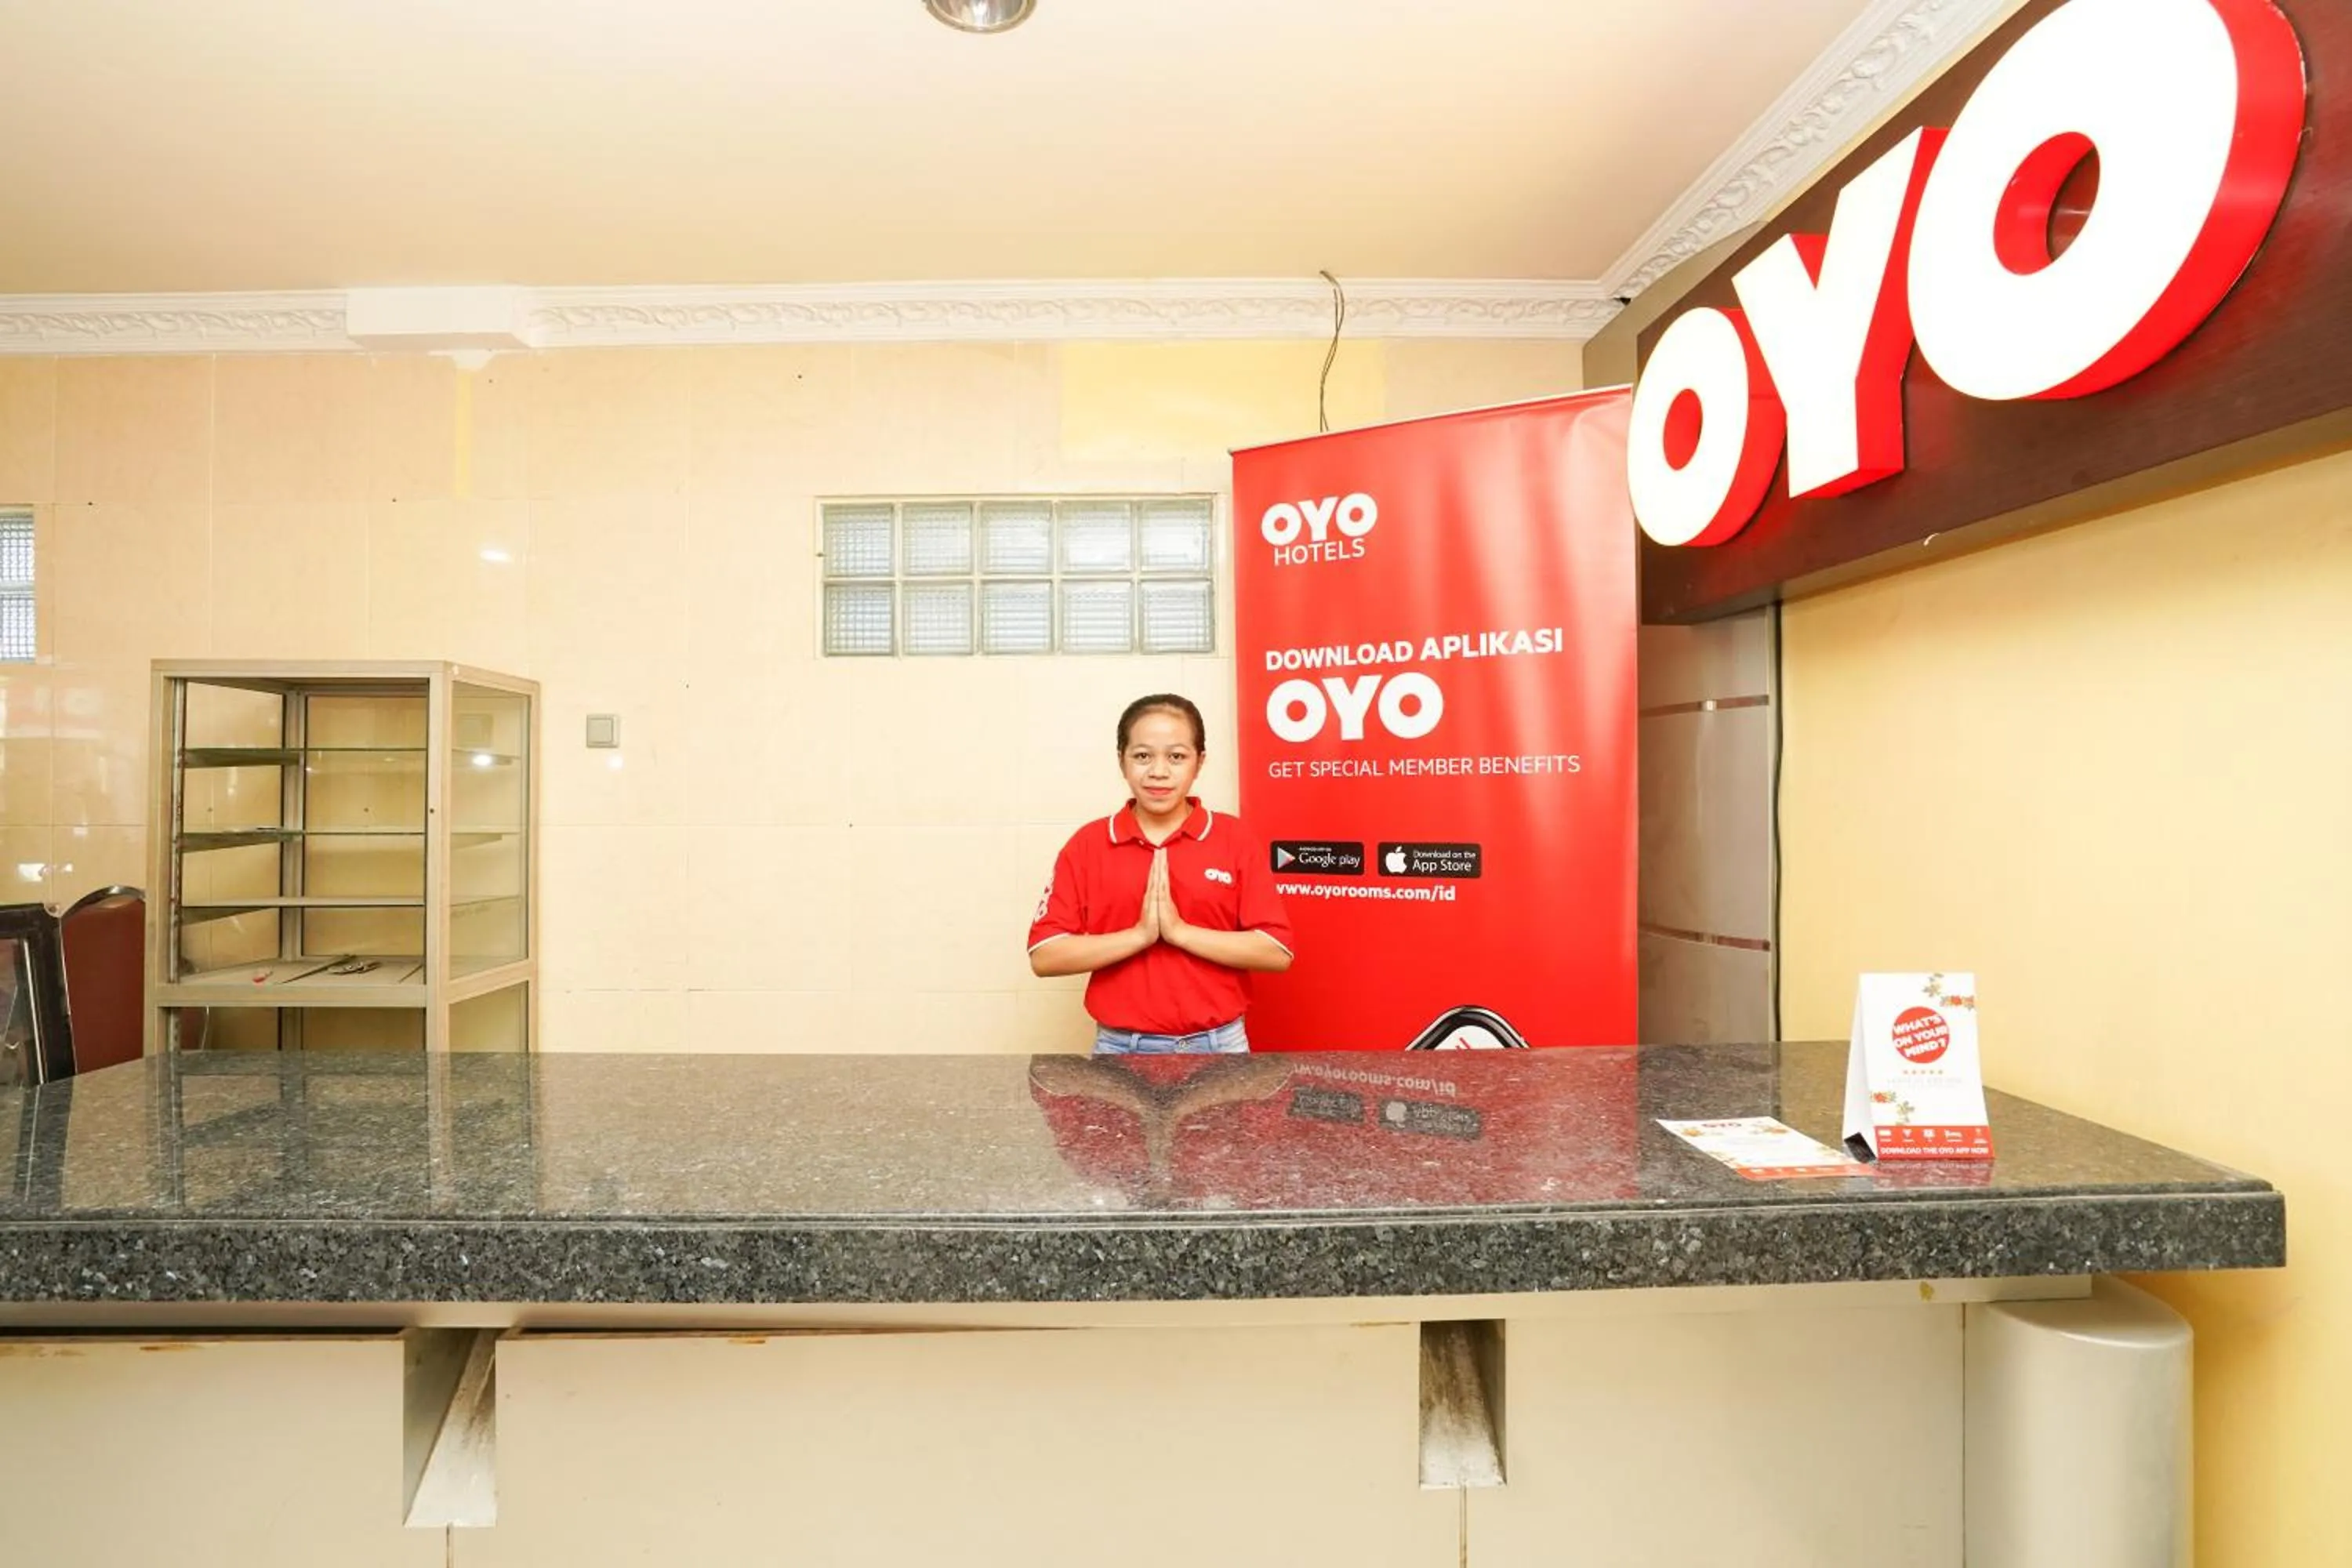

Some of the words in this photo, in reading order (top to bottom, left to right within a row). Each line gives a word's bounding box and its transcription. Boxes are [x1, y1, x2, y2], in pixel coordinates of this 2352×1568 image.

[1627, 0, 2307, 547] OYO
[1261, 492, 1378, 546] OYO
[1273, 537, 1366, 566] HOTELS
[1265, 640, 1414, 671] DOWNLOAD
[1419, 626, 1563, 662] APLIKASI
[1265, 672, 1444, 742] OYO
[1269, 760, 1305, 779] GET
[1309, 758, 1383, 778] SPECIAL
[1388, 757, 1474, 776] MEMBER
[1479, 754, 1581, 775] BENEFITS
[1298, 852, 1337, 868] Google
[1338, 854, 1361, 868] play
[1412, 849, 1451, 859] Download
[1465, 851, 1477, 860] the
[1412, 861, 1437, 873] App
[1440, 860, 1472, 872] Store
[1893, 1035, 1914, 1049] ON
[1912, 1025, 1950, 1042] YOUR
